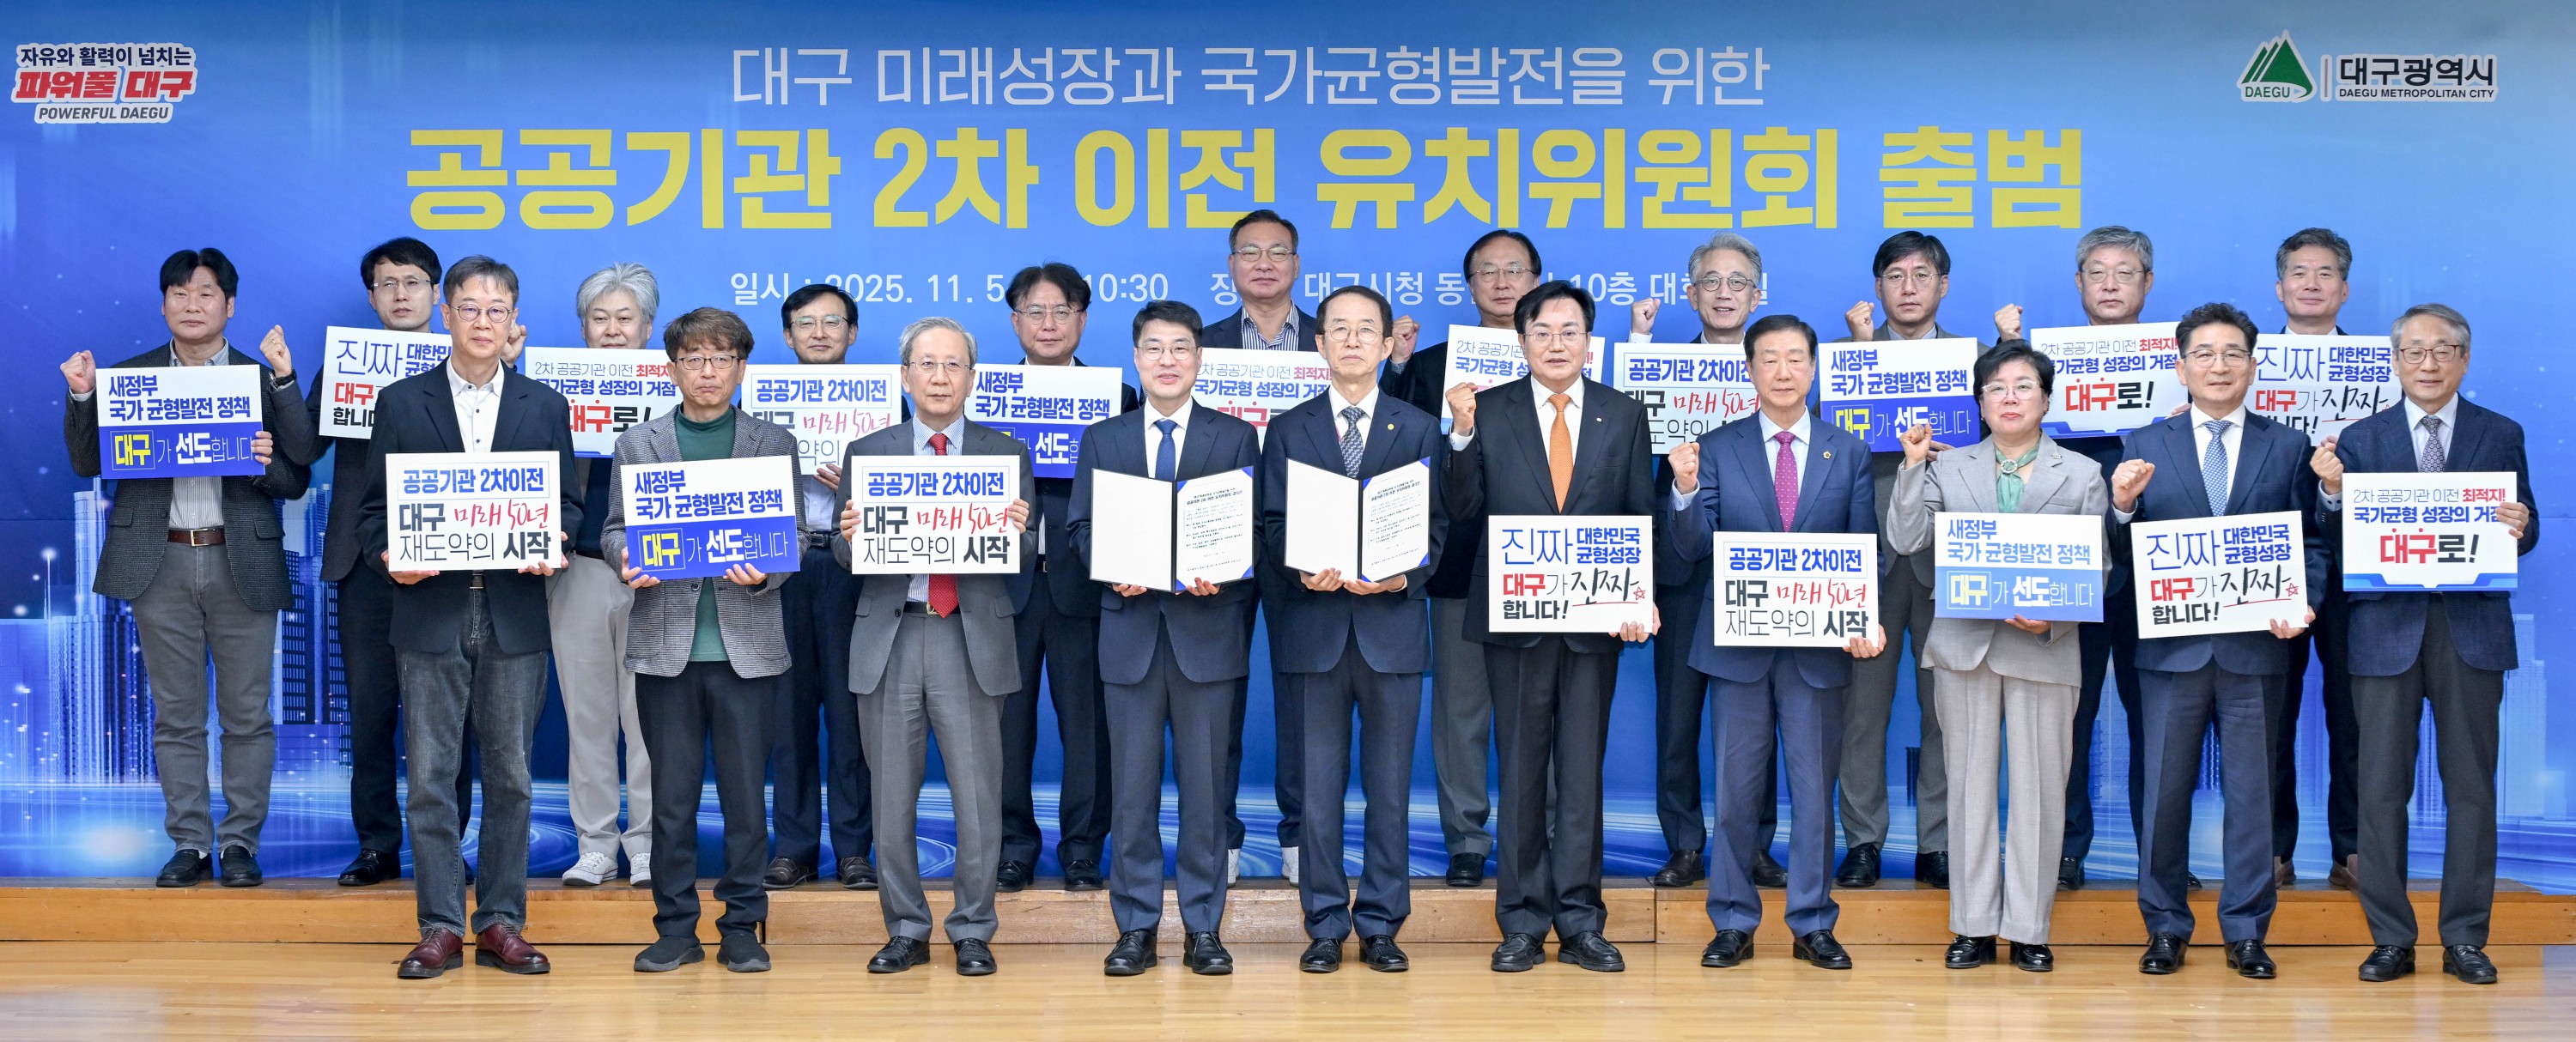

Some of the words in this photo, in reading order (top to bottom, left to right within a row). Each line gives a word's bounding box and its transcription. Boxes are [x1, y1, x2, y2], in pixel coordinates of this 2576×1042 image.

[21, 47, 75, 66] 자유와
[79, 47, 132, 66] 활력이
[138, 47, 192, 66] 넘치는
[733, 47, 853, 106] 대구
[878, 46, 1182, 106] 미래성장과
[1201, 45, 1626, 106] 국가균형발전을
[1648, 46, 1771, 106] 위한
[2340, 58, 2494, 86] 대구광역시
[15, 71, 118, 99] 파워풀
[125, 71, 193, 98] 대구
[2245, 87, 2290, 98] DAEGU
[2339, 89, 2378, 98] DAEGU
[2381, 89, 2467, 98] METROPOLITAN
[2470, 89, 2494, 98] CITY
[39, 107, 118, 119] POWERFUL
[120, 107, 168, 119] DAEGU
[407, 128, 841, 230] 공공기관
[873, 127, 1039, 228] 2차
[1074, 127, 1276, 229] 이전
[1316, 126, 1838, 229] 유치위원회
[1879, 125, 2081, 229] 출범
[731, 273, 789, 306] 일시
[927, 274, 973, 303] 11.
[337, 340, 403, 378] 진짜
[407, 343, 452, 362] 대한민
[1457, 341, 1475, 354] 2차
[2063, 341, 2110, 355] 공공기관
[2113, 340, 2136, 353] 이전
[535, 362, 554, 375] 2차
[557, 362, 606, 376] 공공기관
[609, 364, 633, 377] 이전
[1217, 364, 1264, 379] 공공기관
[1267, 366, 1291, 379] 이전
[1455, 356, 1513, 377] 국가균형
[1629, 359, 1695, 381] 공공기관
[1831, 349, 1879, 372] 새정부
[2103, 355, 2146, 373] 성장의
[2257, 347, 2325, 382] 진짜
[2330, 347, 2391, 364] 대한민국
[976, 372, 1024, 393] 새정부
[1832, 374, 1864, 396] 국가
[1868, 372, 1931, 395] 균형발전
[1935, 370, 1967, 391] 정책
[2329, 365, 2391, 382] 균형성장
[109, 375, 158, 397] 새정부
[334, 382, 386, 406] 대구
[598, 380, 642, 396] 성장의
[647, 381, 677, 397] 거점
[756, 379, 823, 402] 공공기관
[828, 379, 887, 402] 2차이전
[1194, 379, 1252, 397] 국가균형
[1256, 382, 1299, 398] 성장의
[2066, 381, 2154, 411] 대구로!
[109, 400, 143, 421] 국가
[147, 398, 214, 421] 균형발전
[216, 397, 251, 418] 정책
[975, 396, 1007, 417] 국가
[1011, 397, 1074, 420] 균형발전
[1078, 399, 1109, 421] 정책
[1649, 419, 1709, 444] 도약의
[175, 432, 254, 464] 선도합니다
[1036, 433, 1078, 464] 선도합
[403, 469, 476, 494] 공공기관
[480, 468, 544, 493] 2차이전
[635, 470, 686, 494] 새정부
[867, 473, 939, 496] 공공기관
[943, 472, 1005, 496] 2차이전
[636, 497, 671, 519] 국가
[675, 491, 744, 518] 균형발전
[748, 489, 783, 512] 정책
[2354, 489, 2374, 503] 2차
[2377, 489, 2431, 503] 공공기관
[2433, 489, 2459, 503] 이전
[2463, 488, 2506, 502] 최적지!
[399, 503, 446, 531] 대구
[864, 506, 908, 535] 대구
[2354, 506, 2418, 524] 국가균형
[2421, 506, 2470, 524] 성장의
[1947, 519, 1997, 541] 새정부
[399, 532, 495, 562] 재도약의
[503, 531, 550, 560] 시작
[707, 529, 788, 563] 선도합니다
[864, 536, 955, 566] 재도약의
[963, 536, 1010, 565] 시작
[1501, 528, 1573, 565] 진짜
[1577, 527, 1640, 545] 대한민국
[1577, 547, 1641, 564] 균형성장
[1947, 542, 1980, 562] 국가
[1985, 542, 2052, 563] 균형발전
[2057, 544, 2091, 565] 정책
[2147, 531, 2221, 570] 진짜
[2223, 524, 2290, 545] 대한민국
[2224, 544, 2292, 564] 균형성장
[2380, 534, 2479, 564] 대구로!
[1729, 547, 1797, 572] 공공기관
[1801, 548, 1862, 572] 2차이전
[1726, 580, 1769, 607] 대구
[2013, 575, 2094, 608] 선도합니다
[1503, 599, 1569, 620] 합니다!
[2152, 601, 2219, 624] 합니다!
[1726, 609, 1814, 637] 재도약의
[1823, 610, 1869, 638] 시작
